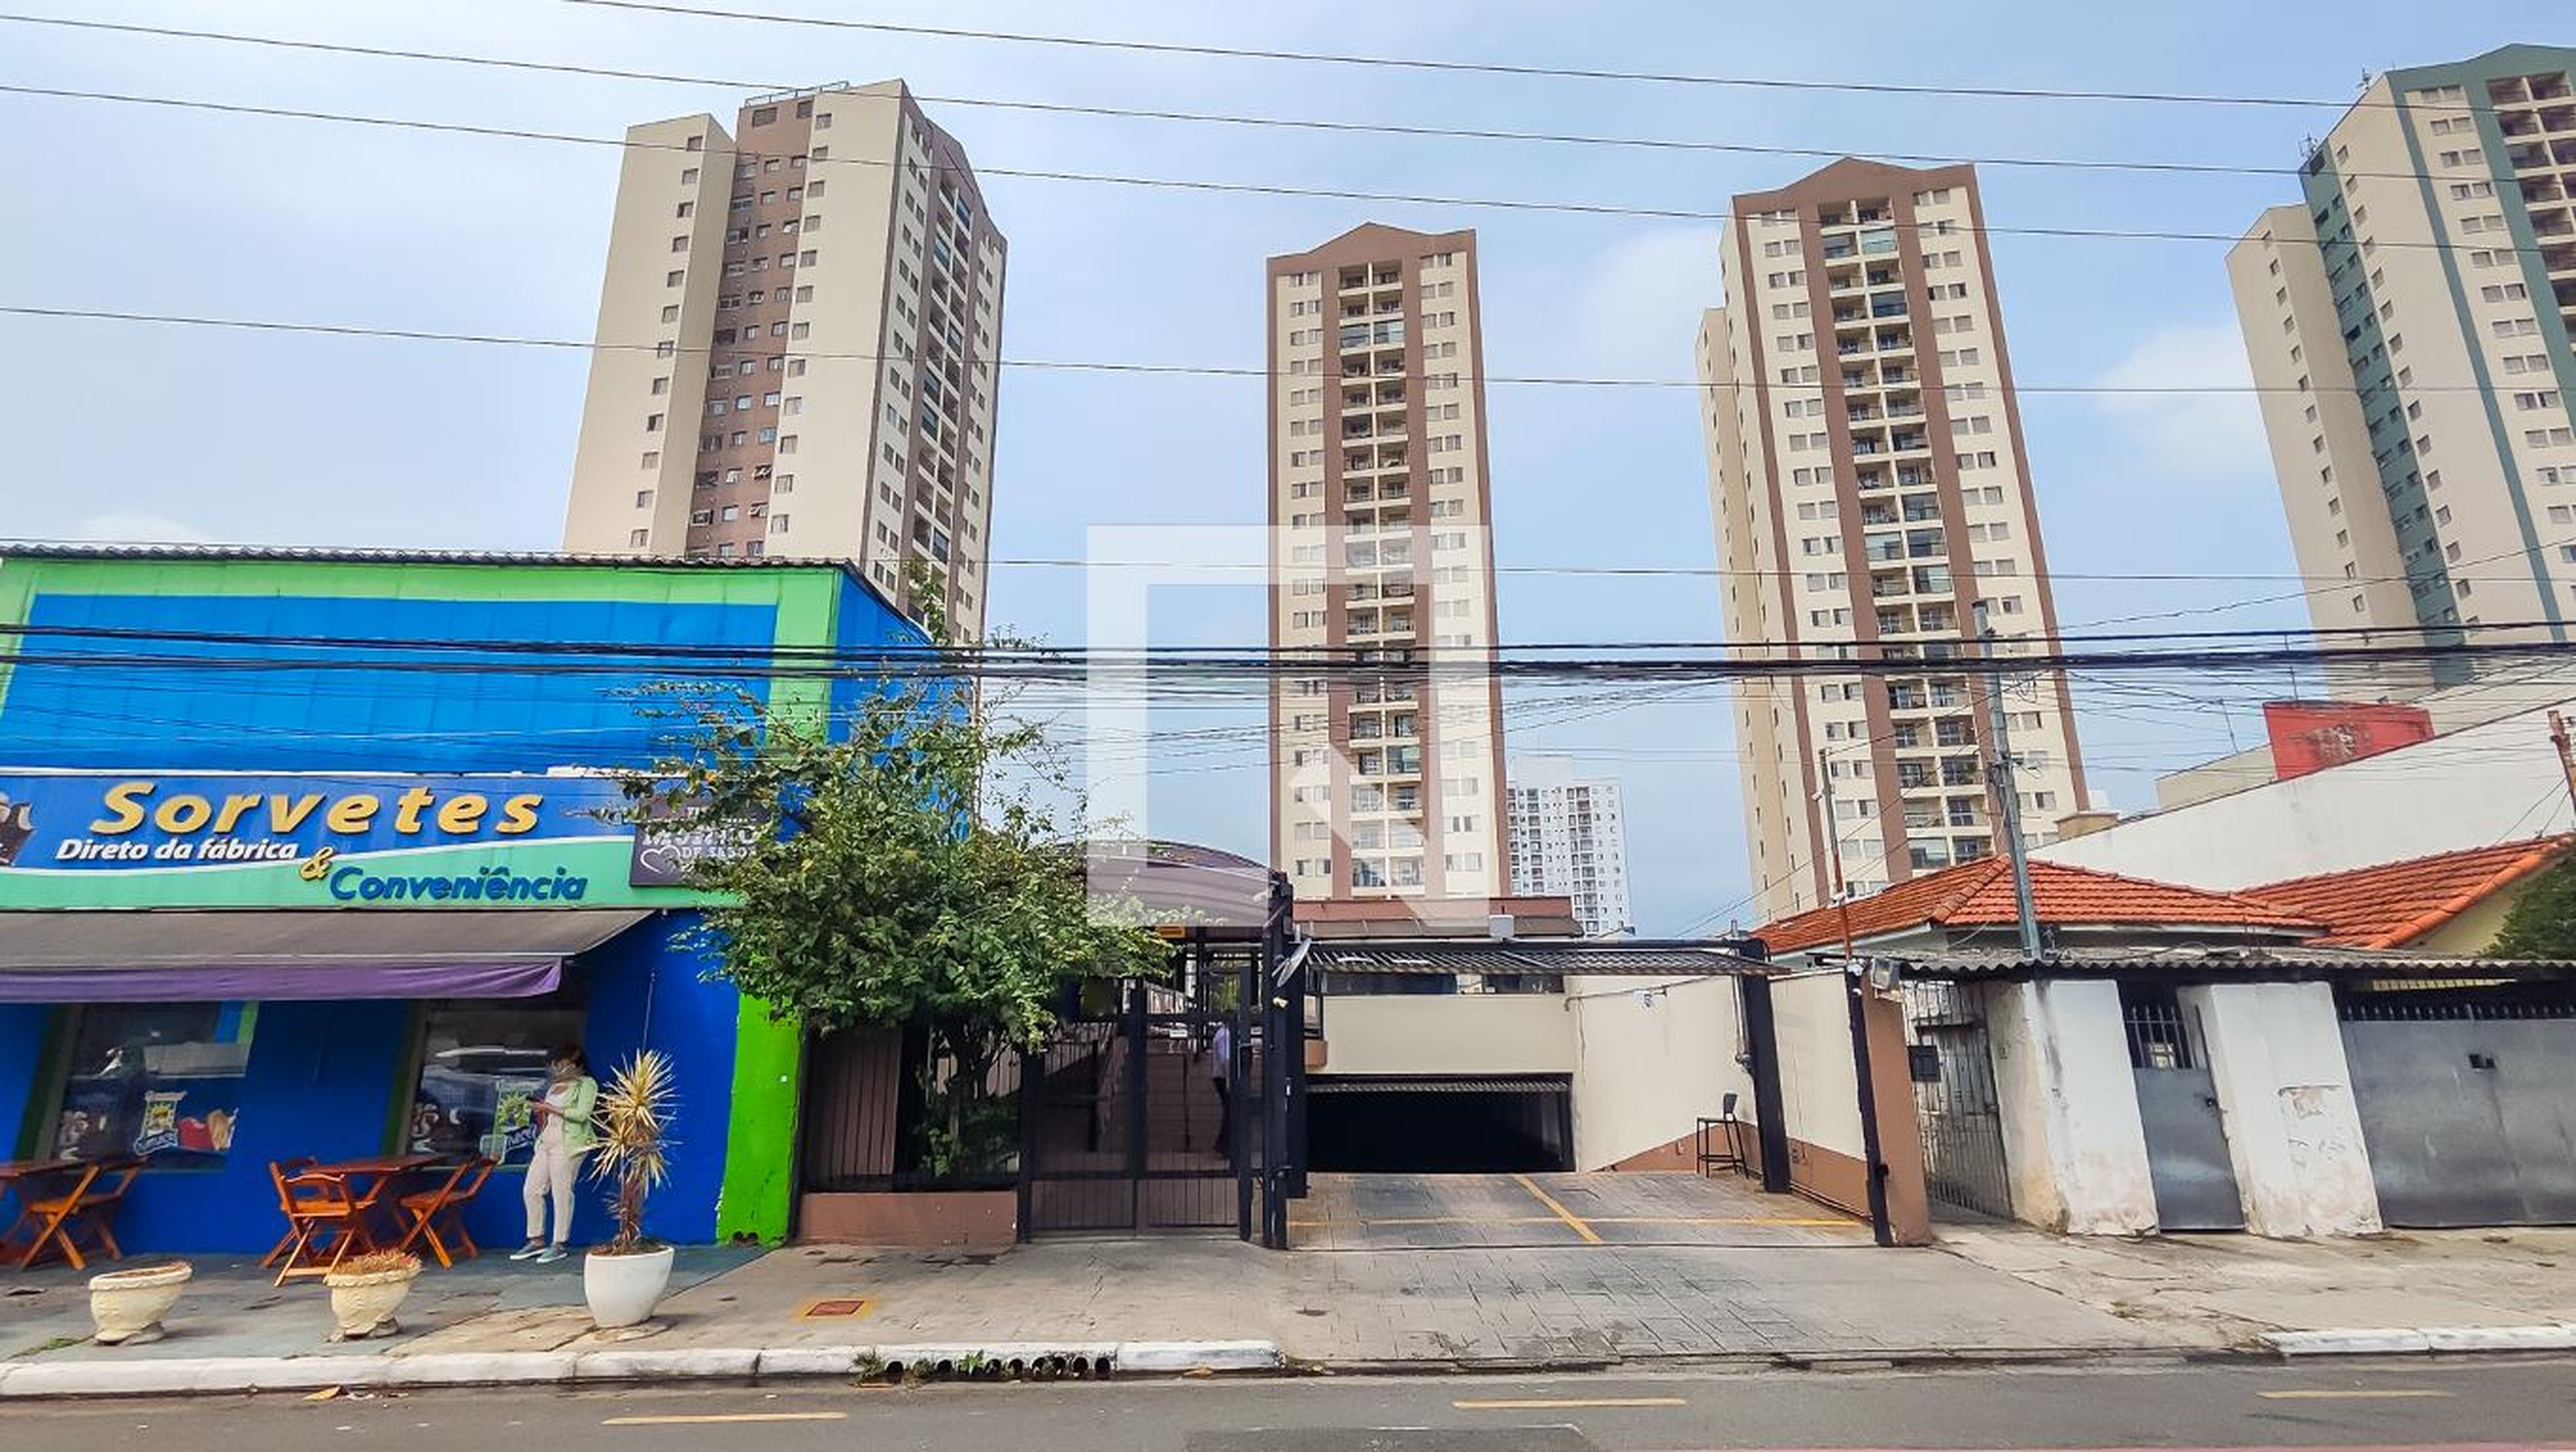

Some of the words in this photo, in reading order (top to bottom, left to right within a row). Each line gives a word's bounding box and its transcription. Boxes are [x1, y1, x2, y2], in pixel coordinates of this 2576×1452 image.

[90, 782, 544, 835] Sorvetes
[55, 838, 149, 860] Direto
[154, 837, 195, 860] da
[197, 837, 299, 860] fábrica
[299, 845, 334, 880] &
[329, 866, 589, 900] Conveniência
